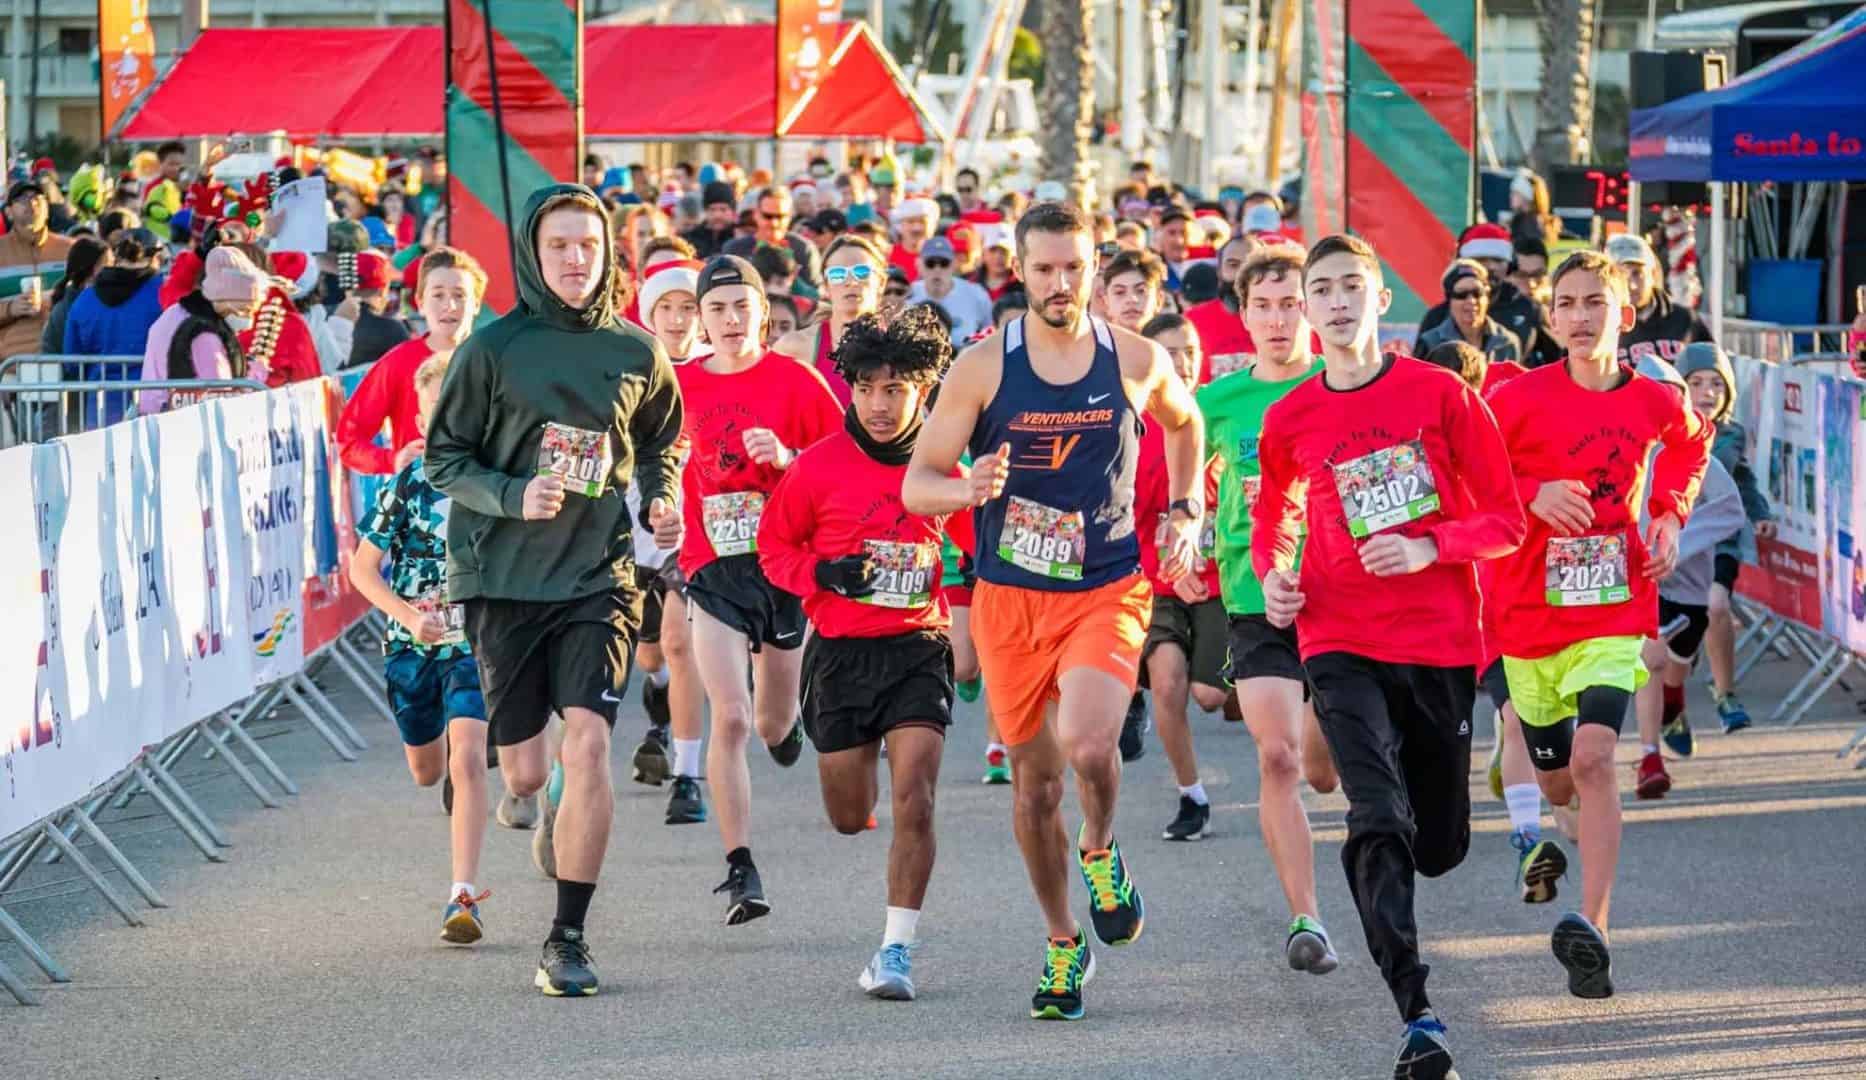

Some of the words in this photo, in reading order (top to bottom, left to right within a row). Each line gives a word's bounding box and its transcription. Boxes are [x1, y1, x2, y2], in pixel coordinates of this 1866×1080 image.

[1733, 131, 1818, 156] Santa
[1828, 131, 1861, 156] to
[1022, 408, 1114, 426] VENTURACERS
[1355, 474, 1424, 517] 2502
[1012, 527, 1072, 564] 2089
[871, 567, 925, 595] 2109
[1559, 563, 1616, 591] 2023
